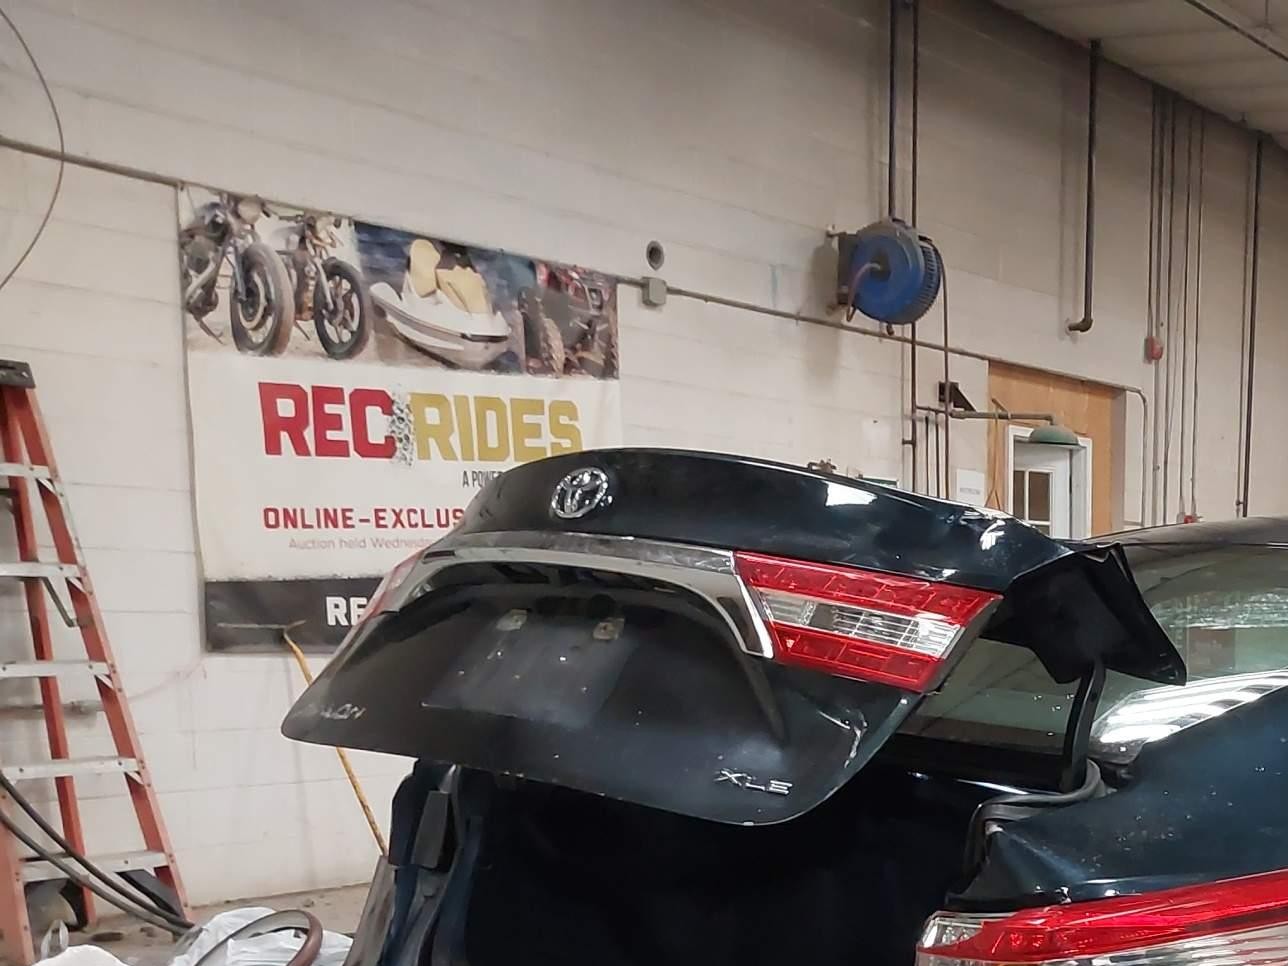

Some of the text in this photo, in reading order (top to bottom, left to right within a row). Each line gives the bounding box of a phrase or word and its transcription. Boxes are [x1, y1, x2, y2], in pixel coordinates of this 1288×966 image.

[258, 382, 583, 462] REC RIDES
[462, 470, 470, 488] A
[263, 507, 464, 530] ONLINE-EXCLUS
[288, 537, 336, 550] Auction
[339, 537, 367, 550] held
[714, 767, 793, 796] XLE
